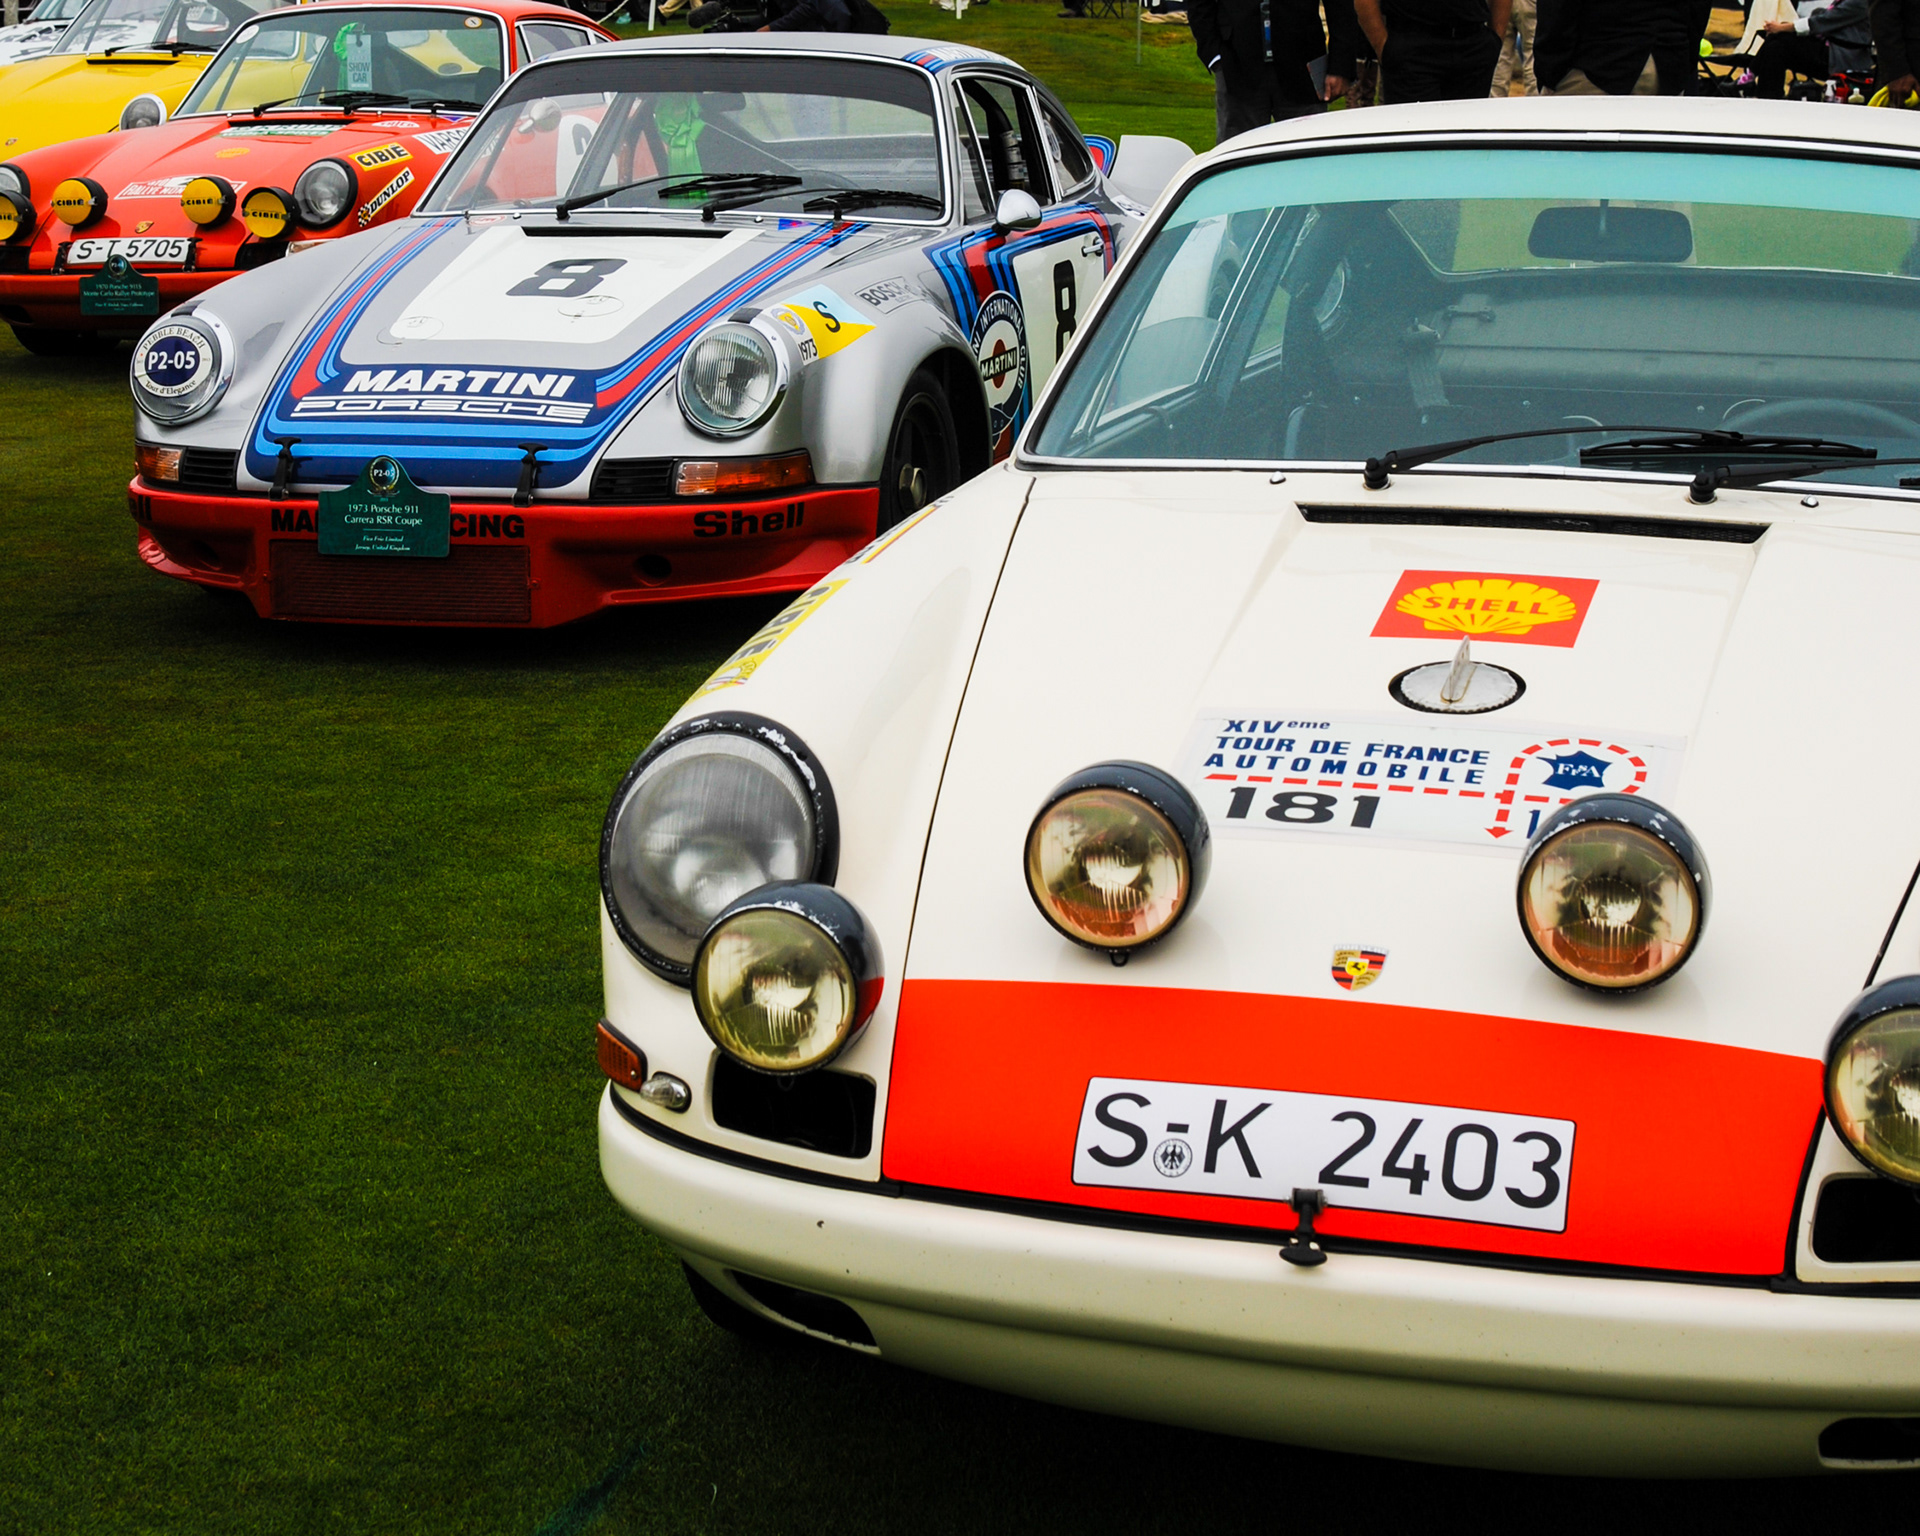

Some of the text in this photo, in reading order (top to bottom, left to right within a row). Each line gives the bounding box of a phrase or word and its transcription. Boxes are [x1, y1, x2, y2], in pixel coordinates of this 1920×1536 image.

[349, 62, 370, 72] SHOW
[353, 72, 367, 82] CAR
[121, 185, 160, 197] RALLYE
[369, 170, 411, 214] DUNLOP
[76, 239, 187, 260] S-T 5705
[505, 258, 628, 298] 8
[114, 290, 130, 298] Rallye
[130, 290, 155, 298] Prototype
[813, 300, 841, 334] S
[1053, 259, 1078, 365] 8
[143, 327, 206, 350] PEBBLE BEACH
[797, 337, 818, 361] 1973
[980, 298, 1026, 390] INTERNATIONAL CLUB
[147, 350, 196, 371] P2-05
[980, 349, 1017, 379] MARTINI
[145, 380, 197, 395] Tour d'Elegance
[343, 369, 576, 399] MARTINI
[294, 397, 595, 422] PORSCHE
[348, 504, 419, 513] 1973 Porsche 911
[693, 501, 805, 538] Shell
[344, 515, 423, 528] Carrera RSR Coupe
[389, 544, 411, 552] Kingdom
[1422, 595, 1551, 616] SHELL
[1214, 736, 1491, 766] TOUR DE FRANCE
[1203, 753, 1486, 786] AUTOMOBILE
[1225, 786, 1381, 829] 181
[1086, 1091, 1274, 1179] S-K
[1317, 1110, 1563, 1209] 2403
